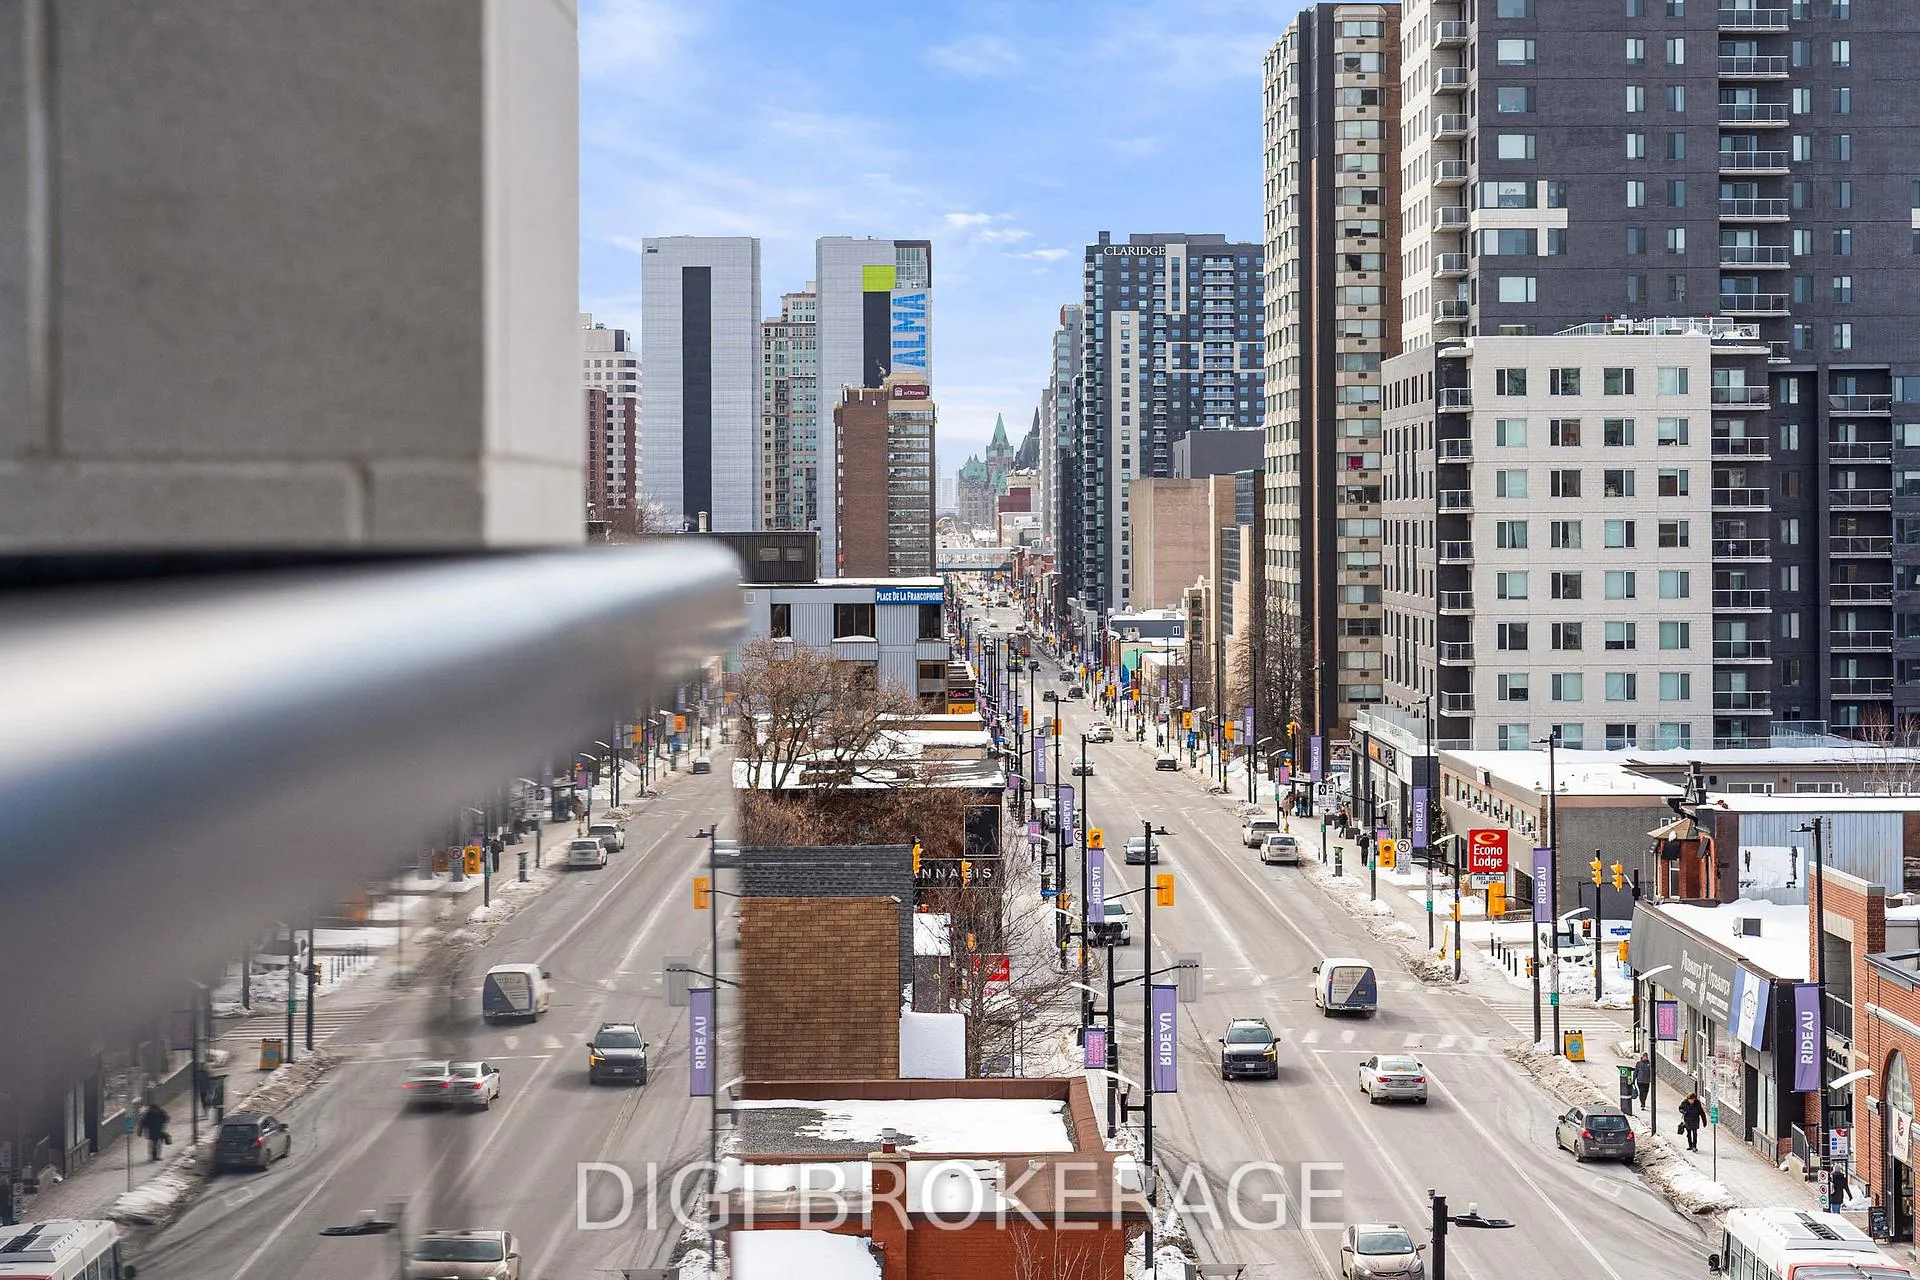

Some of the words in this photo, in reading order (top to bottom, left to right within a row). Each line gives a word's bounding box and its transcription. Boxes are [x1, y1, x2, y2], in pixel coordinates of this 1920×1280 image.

[1104, 246, 1166, 256] CLARIDGE
[892, 293, 926, 367] ALMA
[876, 592, 892, 601] PLACE
[907, 592, 944, 601] FRANCOPHONIE
[1415, 801, 1424, 832] RIDEAU
[1473, 843, 1503, 856] Econo
[1473, 855, 1503, 869] Lodge
[1537, 866, 1547, 904] RIDEAU
[695, 1016, 708, 1069] RIDEAU
[1801, 1011, 1814, 1064] RIDEAU
